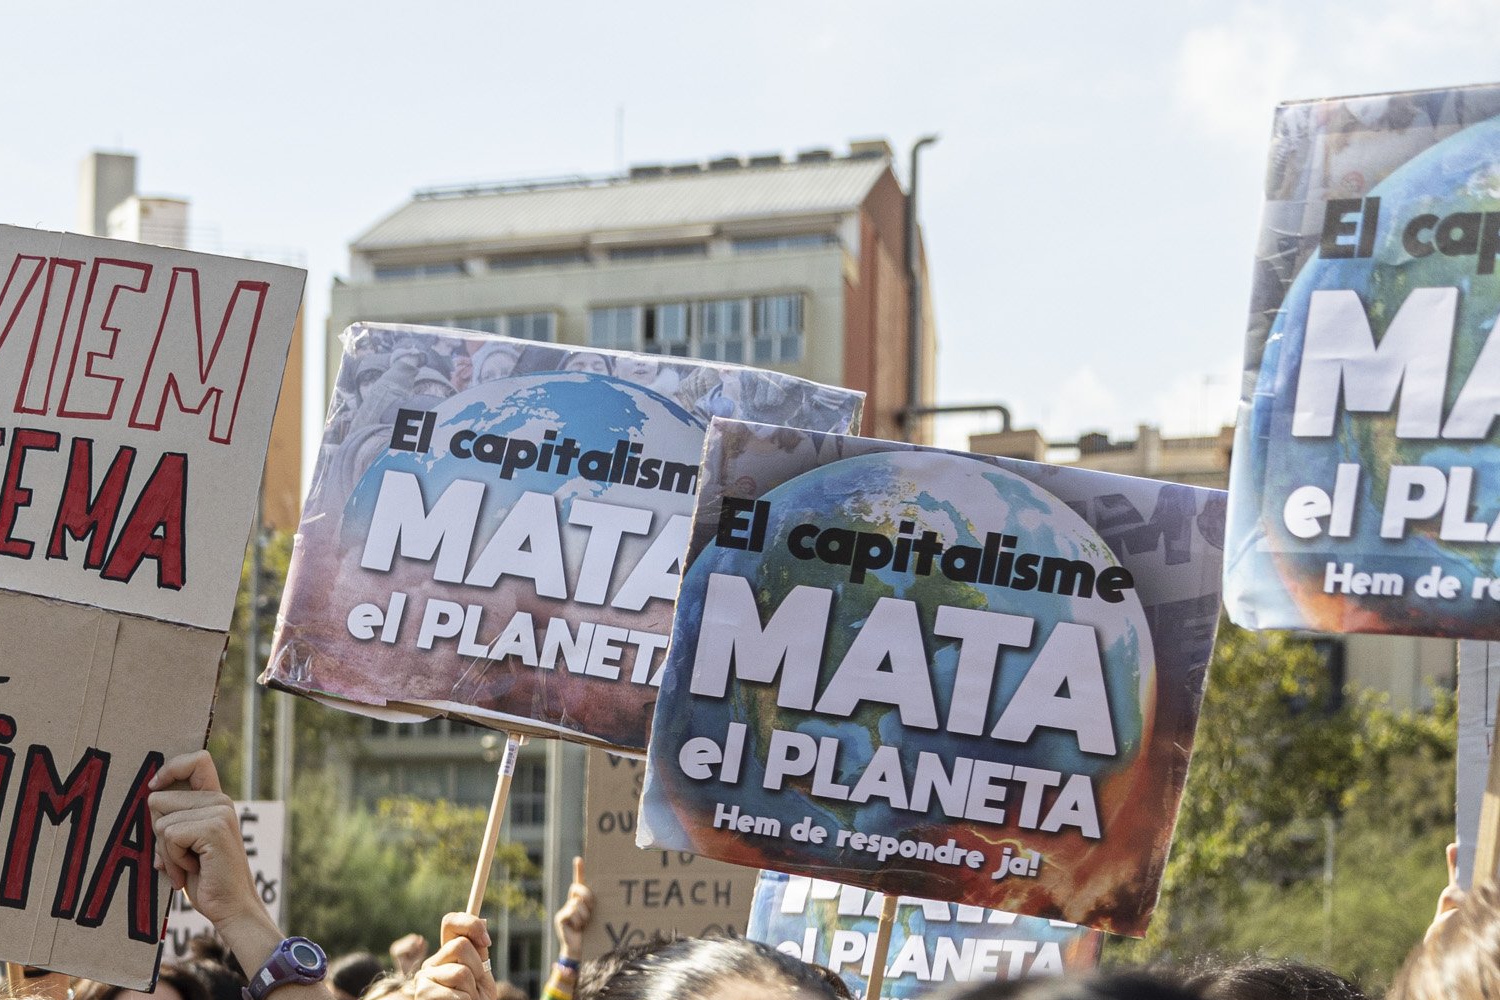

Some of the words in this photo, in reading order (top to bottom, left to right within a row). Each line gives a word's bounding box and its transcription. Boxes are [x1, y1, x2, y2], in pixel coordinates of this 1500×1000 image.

[1319, 196, 1382, 259] El
[388, 408, 436, 454] El
[448, 428, 699, 496] capitalism
[1283, 463, 1361, 539] el
[1379, 465, 1500, 543] PL
[714, 497, 772, 553] El
[786, 520, 1135, 603] capitalisme
[1323, 561, 1405, 597] Hem
[1414, 565, 1462, 599] de
[346, 592, 408, 645] el
[416, 598, 672, 688] PLANET
[689, 573, 1117, 756] MATA
[679, 723, 747, 784] el
[761, 730, 1102, 840] PLANETA
[713, 803, 781, 838] Hem
[789, 816, 829, 846] de
[835, 830, 986, 870] respondre
[991, 851, 1042, 880] ja!
[619, 878, 732, 908] TEACH
